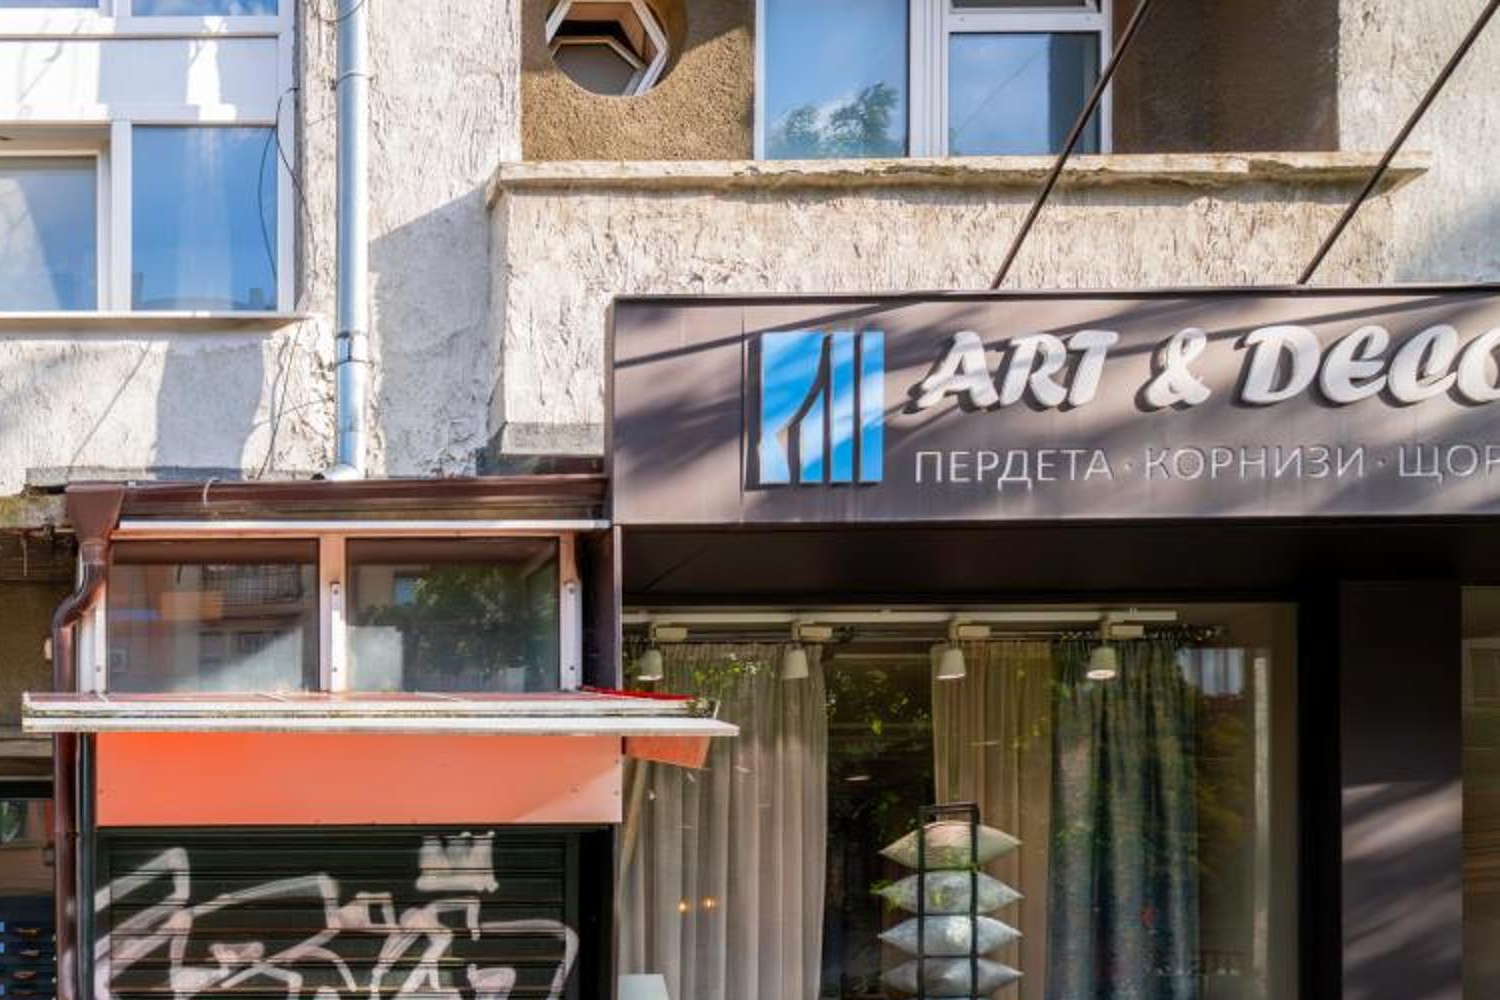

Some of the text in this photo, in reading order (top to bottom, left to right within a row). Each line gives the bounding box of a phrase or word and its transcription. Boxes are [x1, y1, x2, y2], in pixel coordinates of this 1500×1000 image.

[916, 329, 1120, 408] ART
[1145, 327, 1212, 406] &
[914, 449, 1115, 492] ПЕРДЕТА
[1145, 446, 1366, 481] КОРНИЗИ
